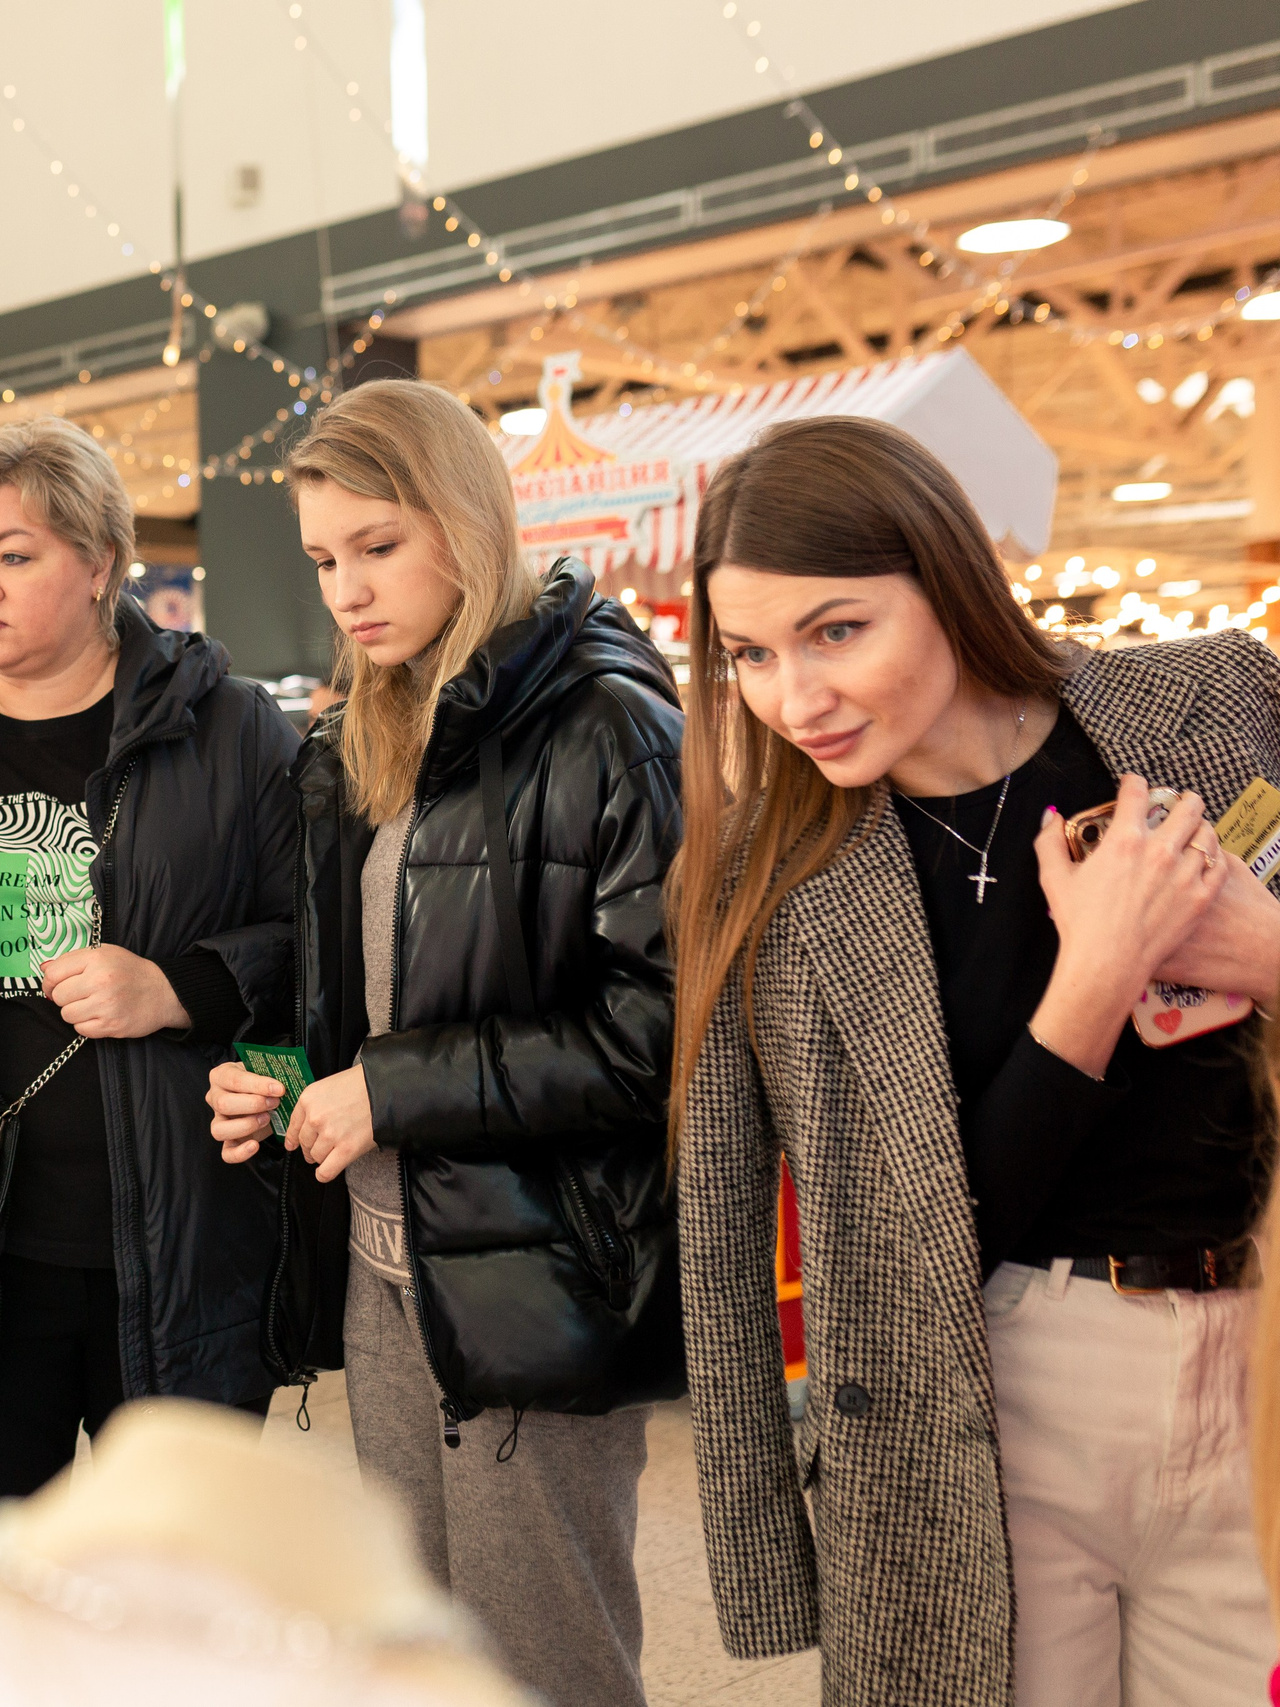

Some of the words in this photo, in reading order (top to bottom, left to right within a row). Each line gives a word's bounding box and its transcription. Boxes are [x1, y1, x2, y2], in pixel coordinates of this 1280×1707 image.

[514, 459, 670, 499] МЕЛАНДИЯ
[6, 793, 24, 804] THE
[20, 901, 69, 919] STAY
